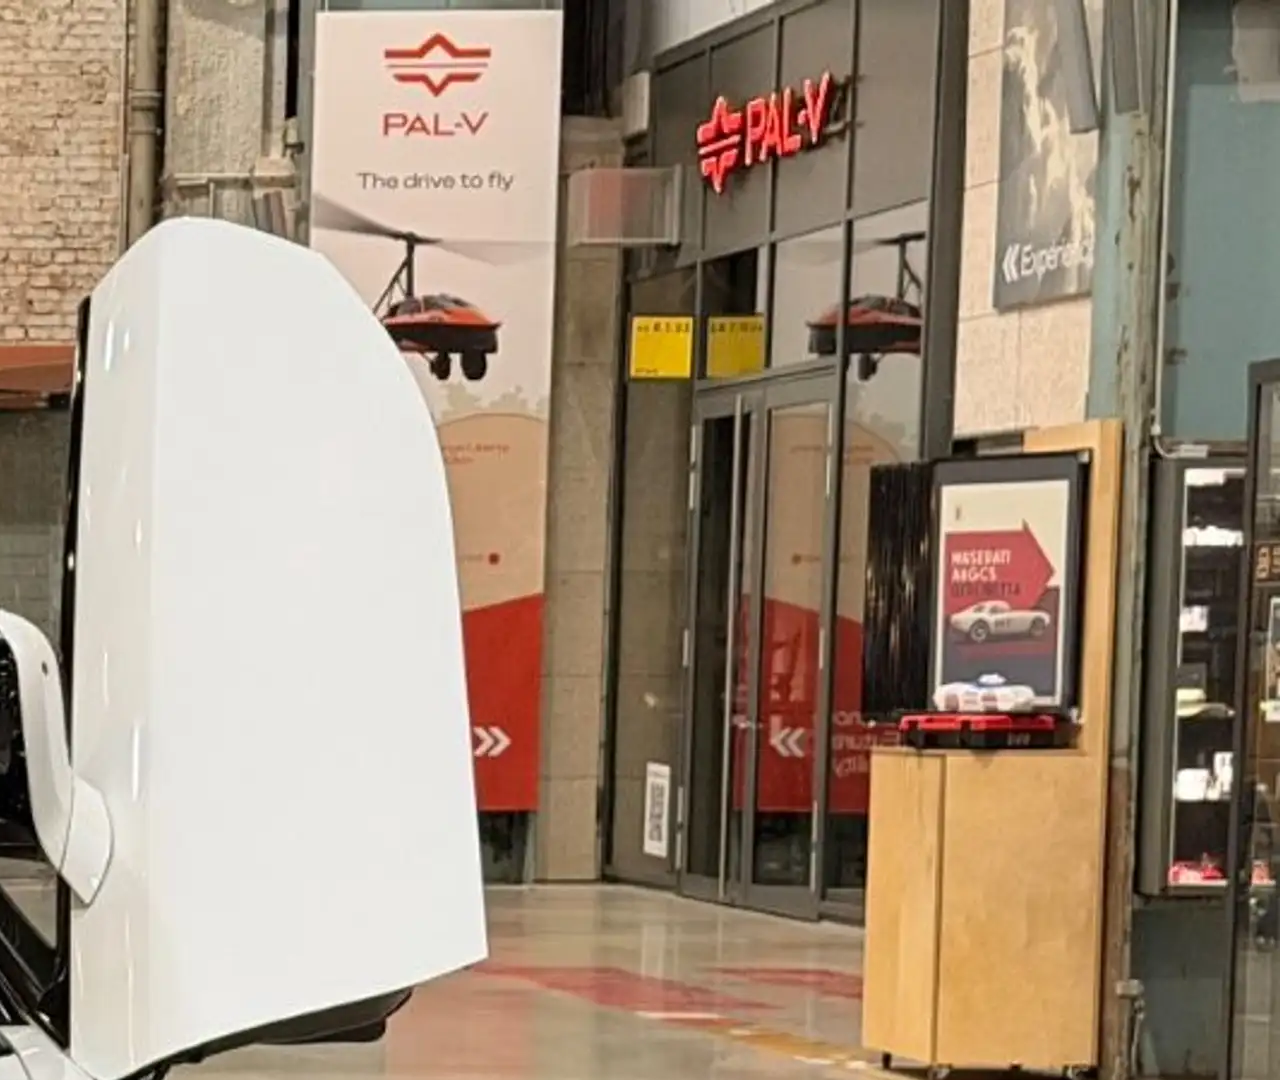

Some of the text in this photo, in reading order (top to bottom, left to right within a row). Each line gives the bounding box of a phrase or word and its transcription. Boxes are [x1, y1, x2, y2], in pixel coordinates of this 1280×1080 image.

[383, 112, 489, 137] PAL-V
[745, 69, 830, 166] PAL-V
[357, 171, 514, 192] The drive to fly
